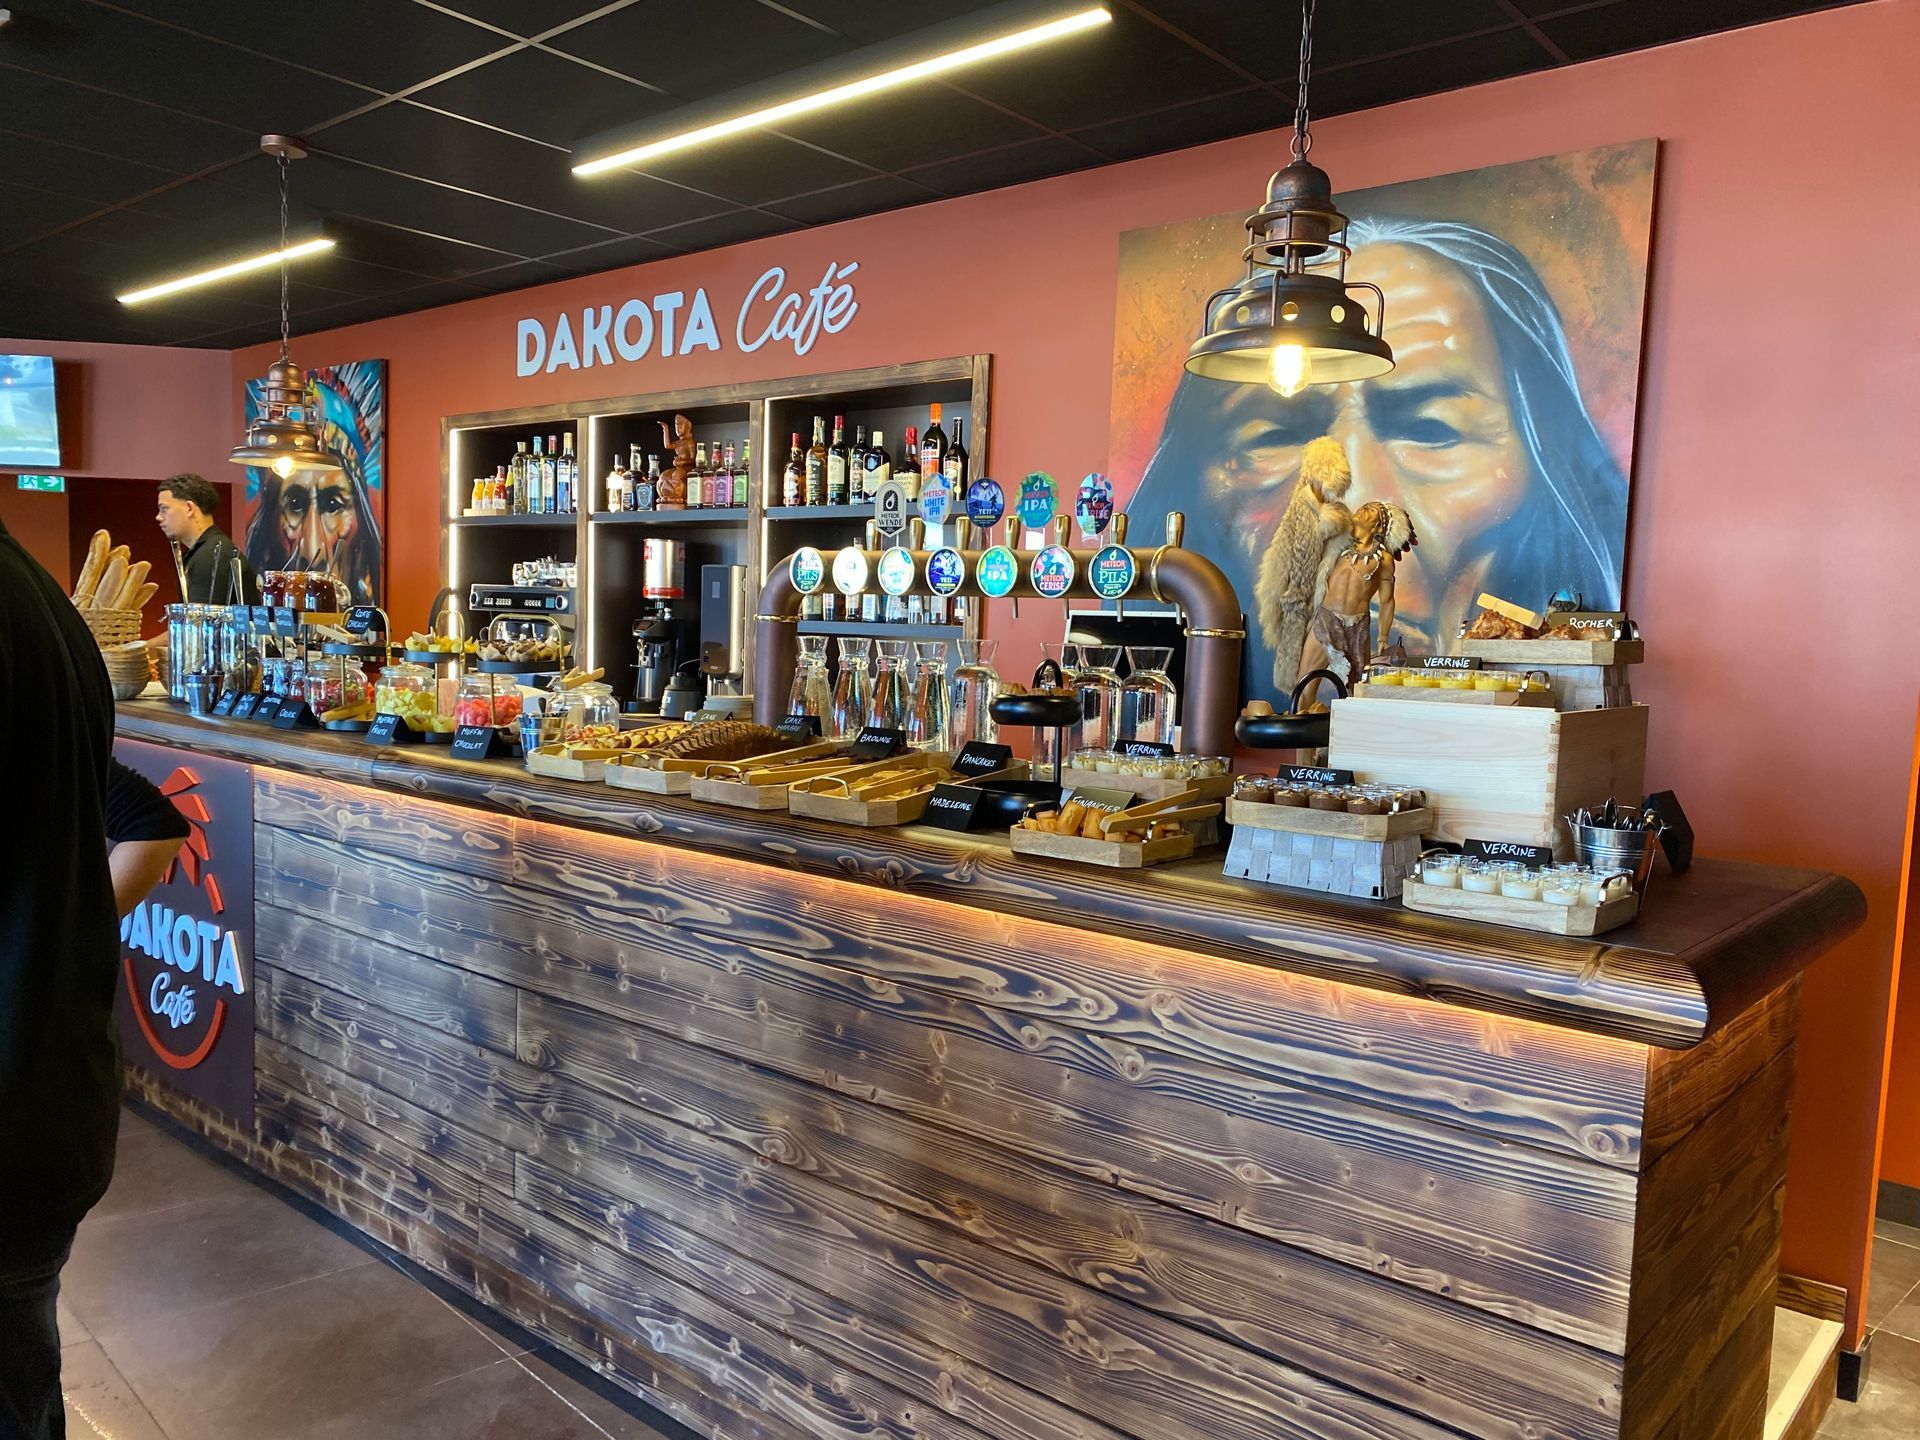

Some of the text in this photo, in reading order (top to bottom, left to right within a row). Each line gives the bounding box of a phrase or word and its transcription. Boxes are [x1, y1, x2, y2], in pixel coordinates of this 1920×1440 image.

[516, 261, 861, 377] DAKOTA Café
[923, 489, 947, 497] METEOR
[924, 497, 945, 507] WHITE
[1024, 499, 1048, 511] IPA
[929, 506, 940, 516] IPA
[1100, 560, 1125, 568] METEOR
[797, 570, 818, 581] PILS
[986, 571, 1008, 581] IPA
[1098, 571, 1128, 584] PILS
[1040, 582, 1065, 591] CERISE
[1569, 617, 1615, 629] ROCHER
[1423, 657, 1470, 668] VERRINE
[461, 728, 484, 736] MUFFIN
[454, 740, 484, 750] CHOCOLAT
[1125, 743, 1162, 757] VERRINE
[960, 753, 997, 767] PANCAKES
[1290, 768, 1336, 781] VERRINE
[929, 797, 972, 811] MADELEINE
[1482, 842, 1536, 858] VERRINE
[150, 972, 196, 1029] Café
